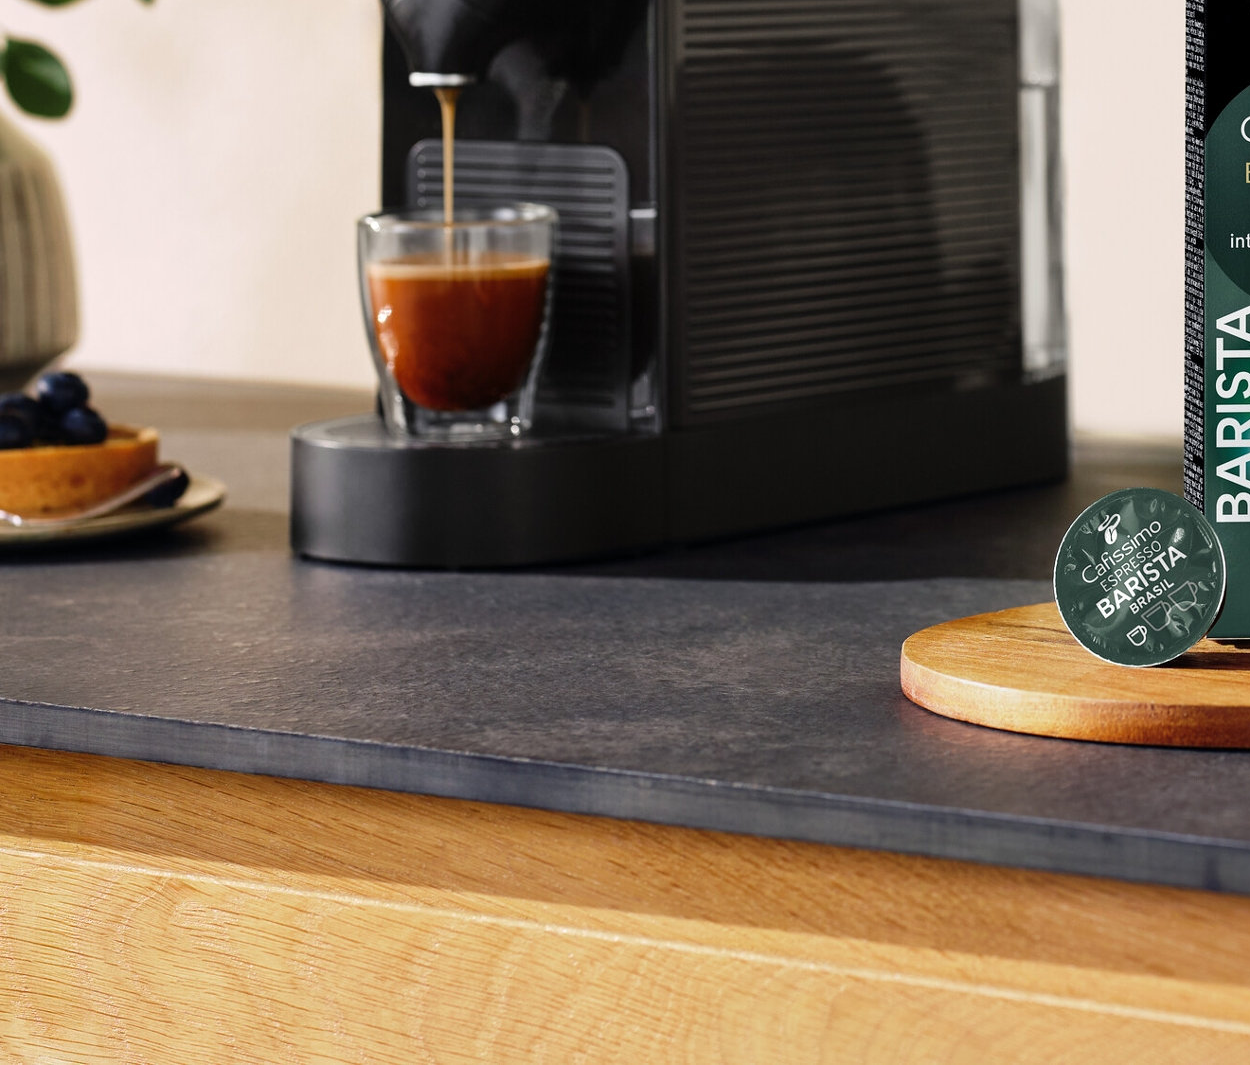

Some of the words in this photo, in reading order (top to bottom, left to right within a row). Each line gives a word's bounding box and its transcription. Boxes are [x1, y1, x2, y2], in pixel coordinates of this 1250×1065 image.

[1082, 520, 1162, 583] Cafissimo
[1100, 540, 1162, 592] ESPRESSO
[1096, 546, 1187, 619] BARISTA
[1130, 579, 1175, 614] BRASIL
